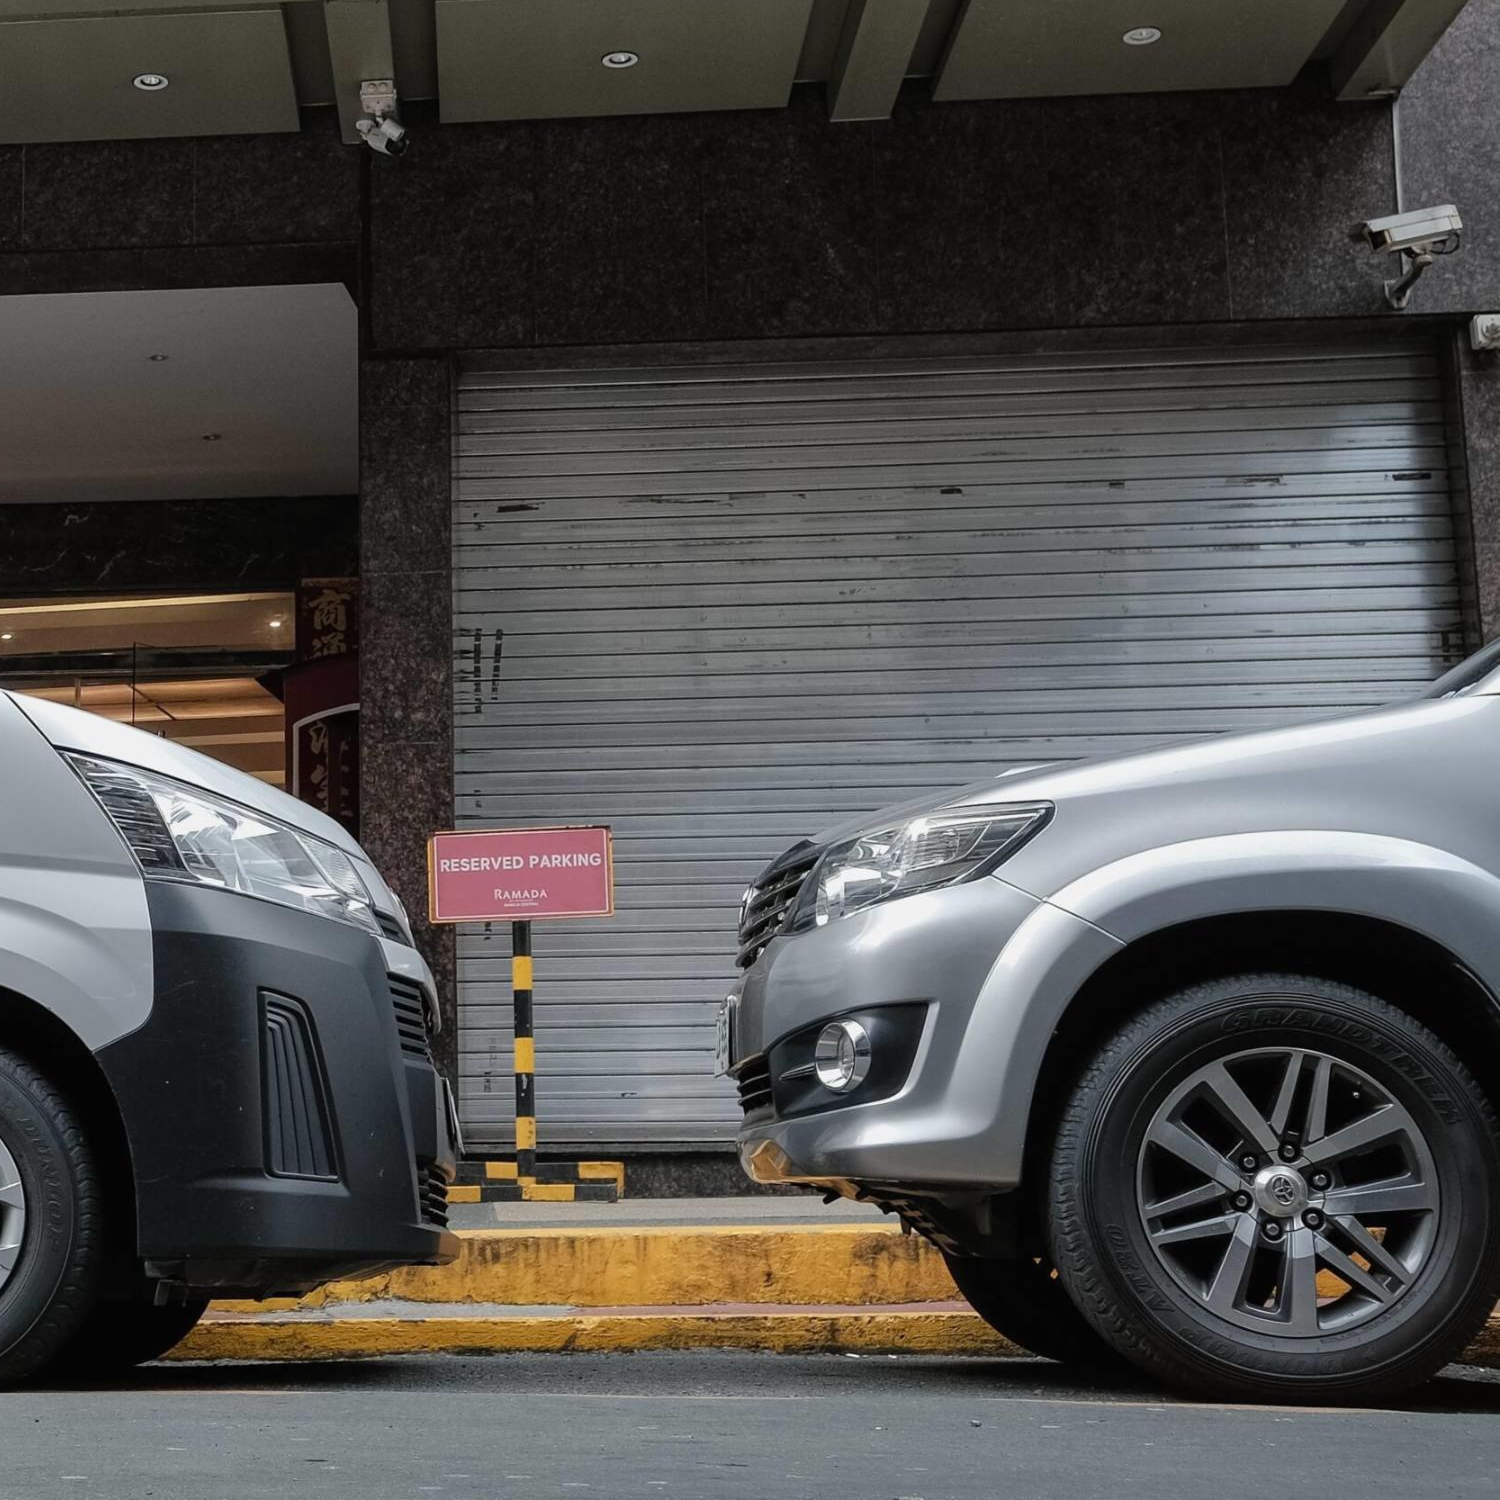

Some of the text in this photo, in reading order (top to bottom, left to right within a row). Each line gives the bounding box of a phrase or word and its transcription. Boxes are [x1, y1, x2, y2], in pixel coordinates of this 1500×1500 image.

[440, 852, 602, 873] RESERVED PARKING
[494, 888, 548, 901] RAMADA
